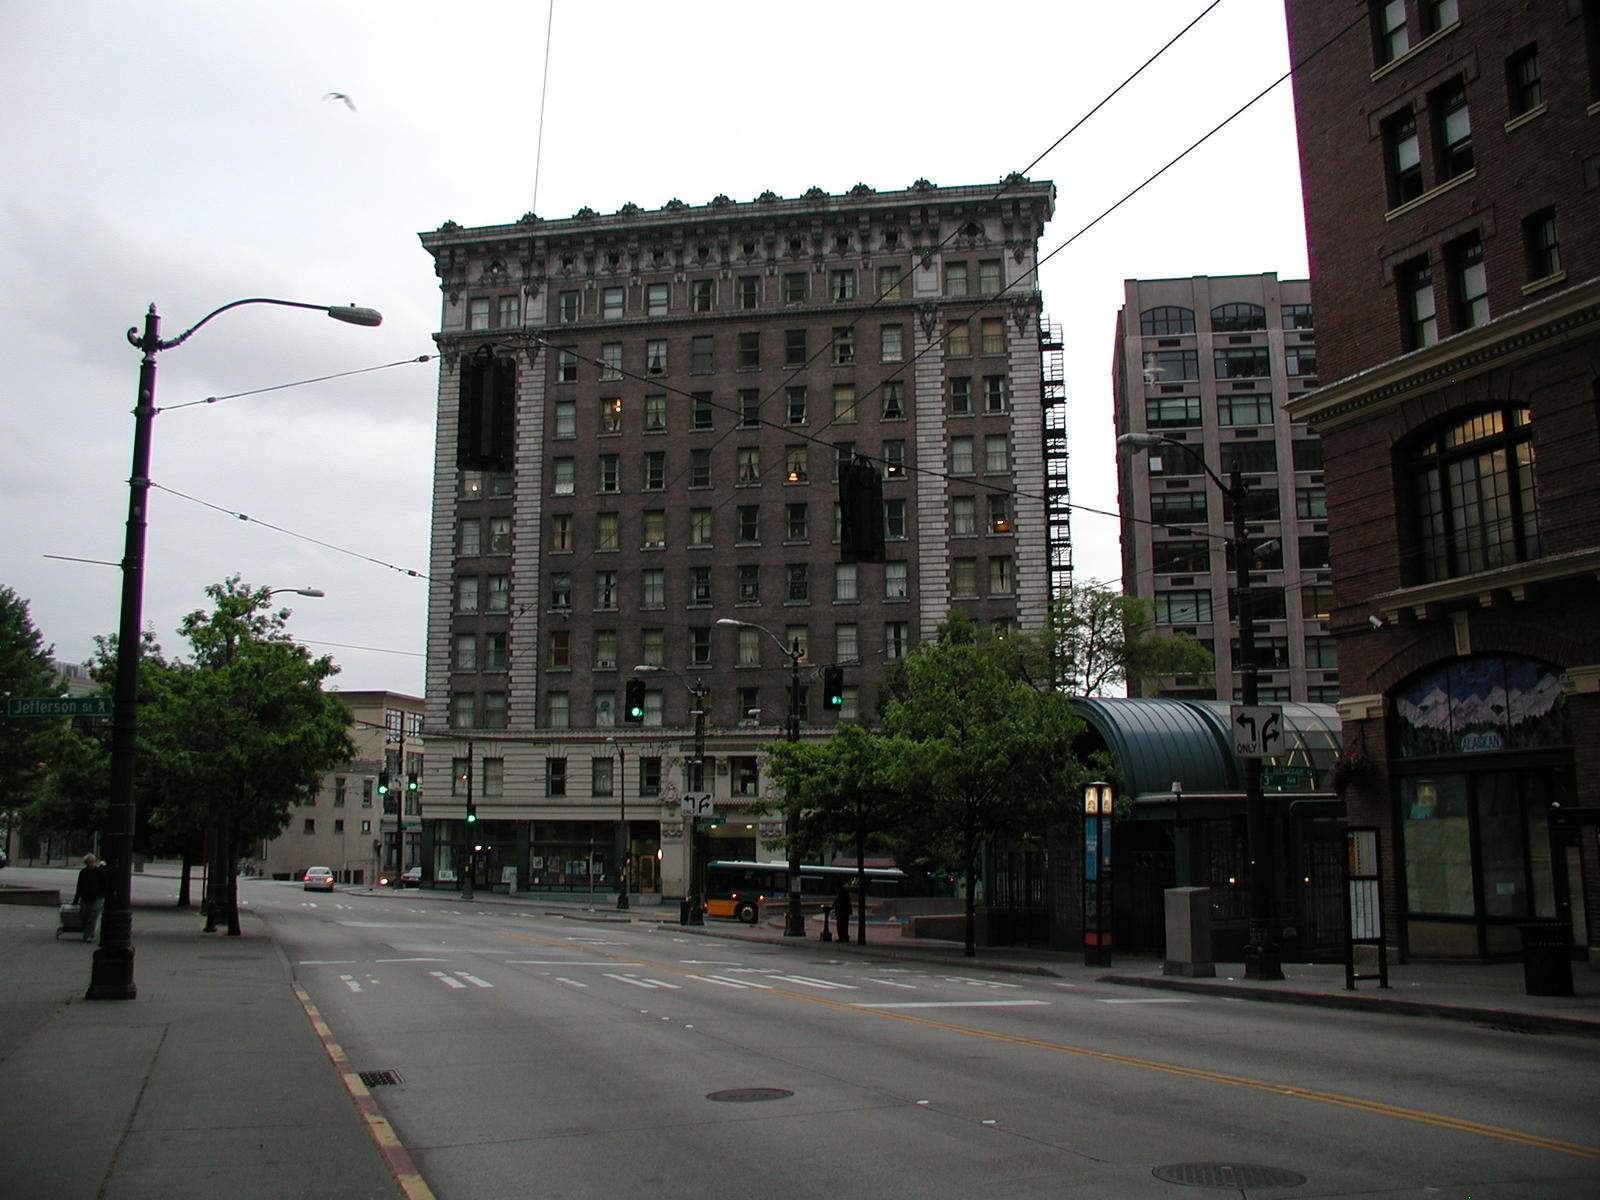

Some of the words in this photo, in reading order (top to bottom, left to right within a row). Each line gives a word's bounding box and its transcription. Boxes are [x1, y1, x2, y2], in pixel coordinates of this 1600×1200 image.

[13, 700, 77, 714] Jefferson
[82, 704, 93, 713] St
[1236, 743, 1257, 753] ONLY
